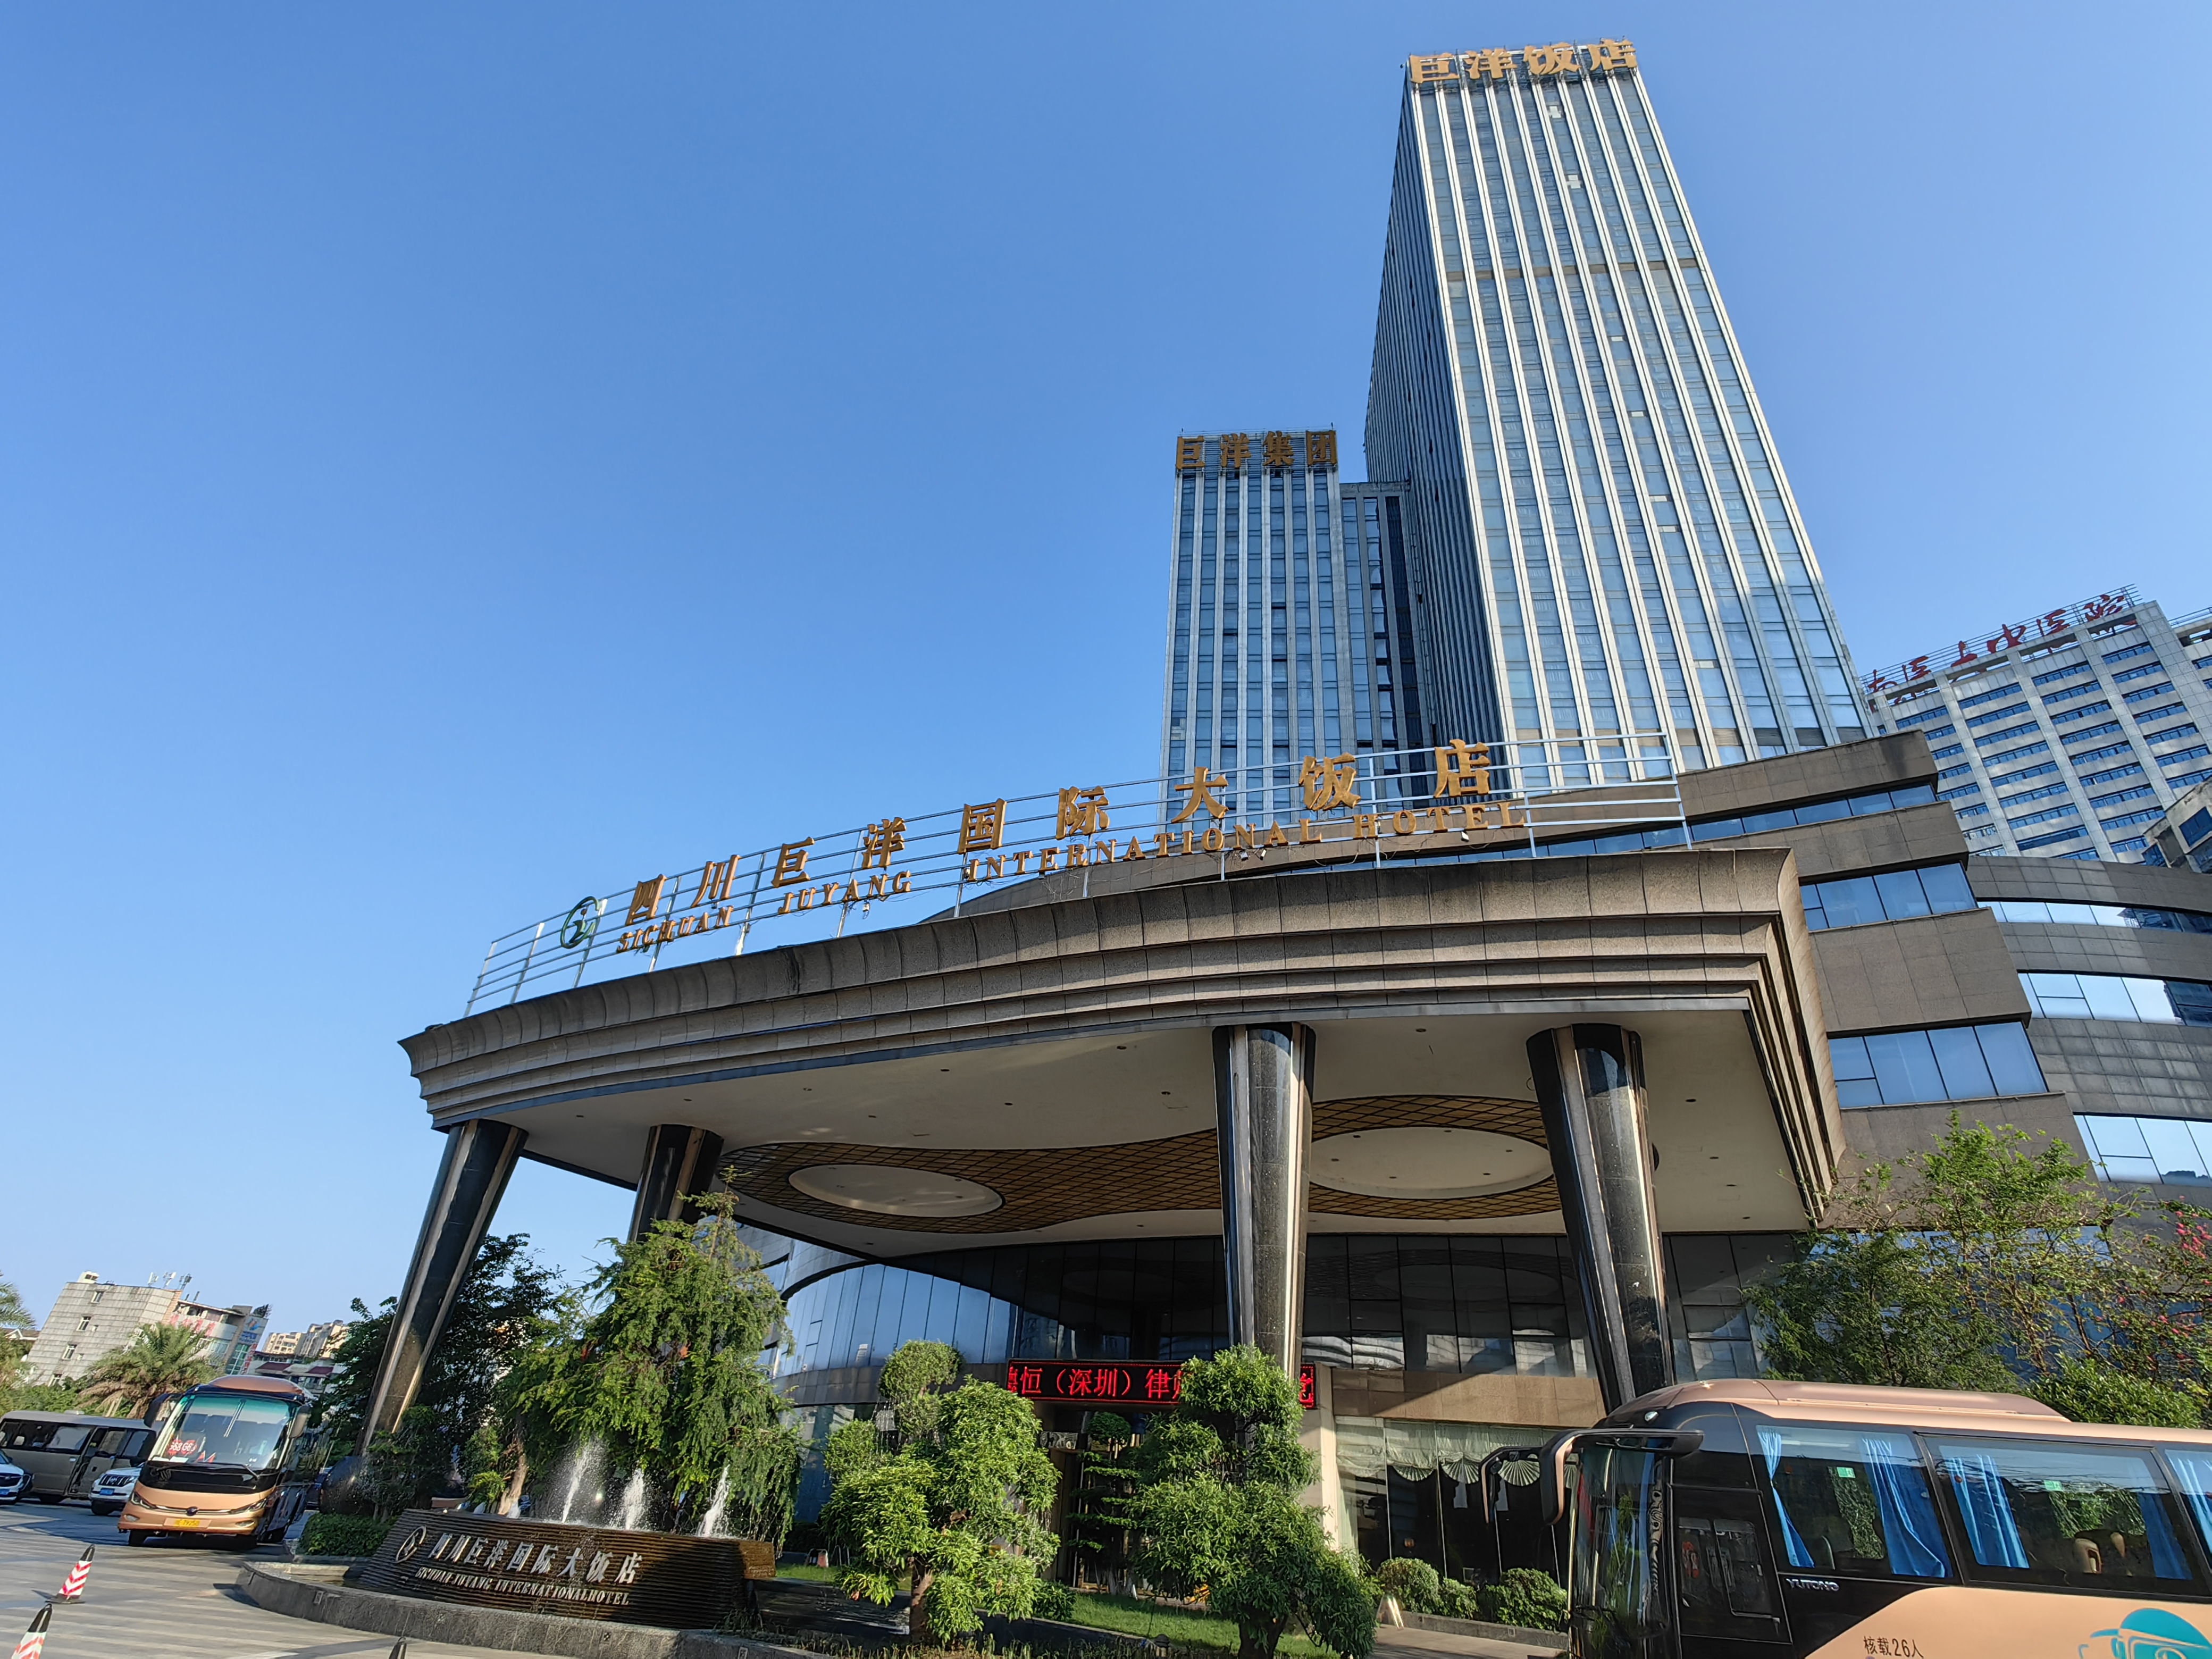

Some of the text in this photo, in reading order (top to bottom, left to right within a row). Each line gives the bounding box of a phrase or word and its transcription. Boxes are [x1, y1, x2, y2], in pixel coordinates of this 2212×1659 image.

[1409, 39, 1637, 83] 巨洋饭店
[1175, 430, 1337, 470] 巨洋集团
[616, 801, 1524, 953] SICHUAN JUYANG INTERNATIONAL HOTEL
[1863, 1636, 1924, 1658] 核载26人
